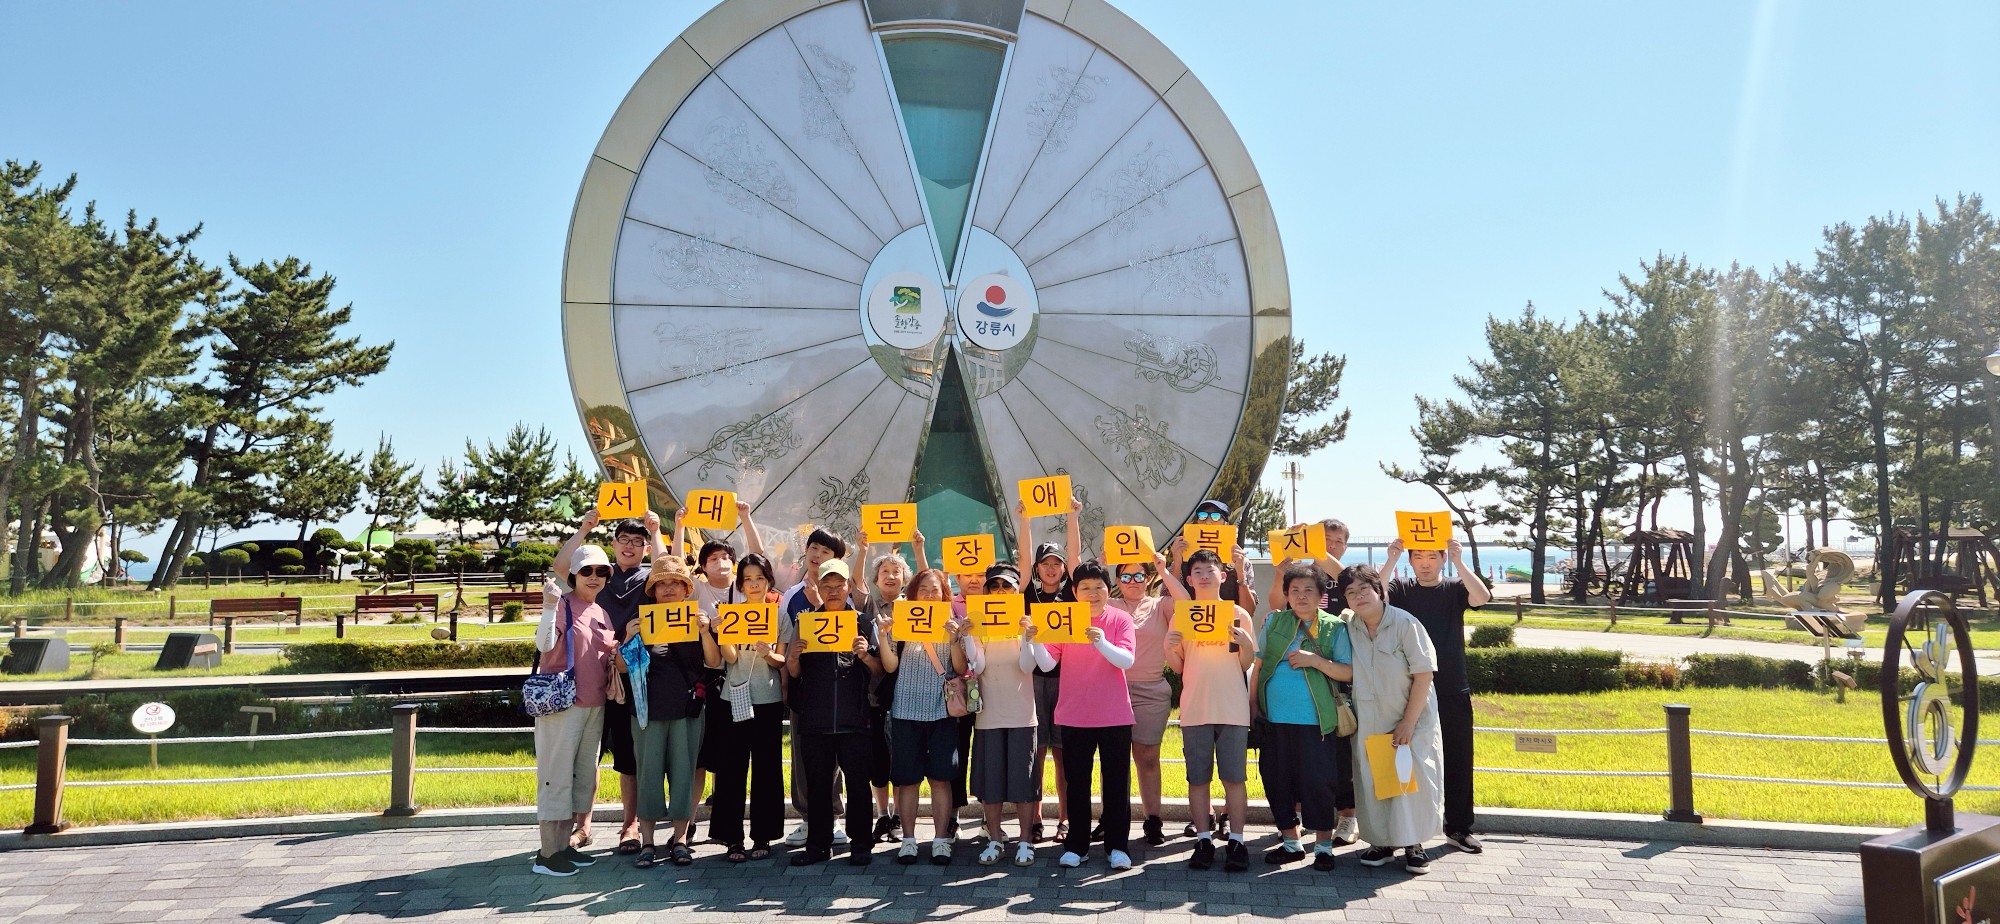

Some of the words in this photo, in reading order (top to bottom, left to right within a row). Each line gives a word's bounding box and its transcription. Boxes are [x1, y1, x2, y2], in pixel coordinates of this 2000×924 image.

[975, 320, 1016, 337] 강릉시
[606, 486, 632, 511] 서
[1032, 481, 1057, 508] 애
[698, 495, 724, 522] 대
[876, 509, 903, 535] 문
[1115, 531, 1140, 556] 인
[1197, 529, 1222, 555] 복
[1283, 529, 1308, 553] 지
[1410, 518, 1438, 542] 관
[956, 539, 982, 566] 장
[644, 605, 696, 635] 1박
[722, 607, 769, 636] 2일
[907, 605, 933, 634] 원
[981, 601, 1010, 626] 도
[1046, 606, 1073, 636] 여
[1189, 604, 1216, 633] 행
[813, 615, 844, 645] 강
